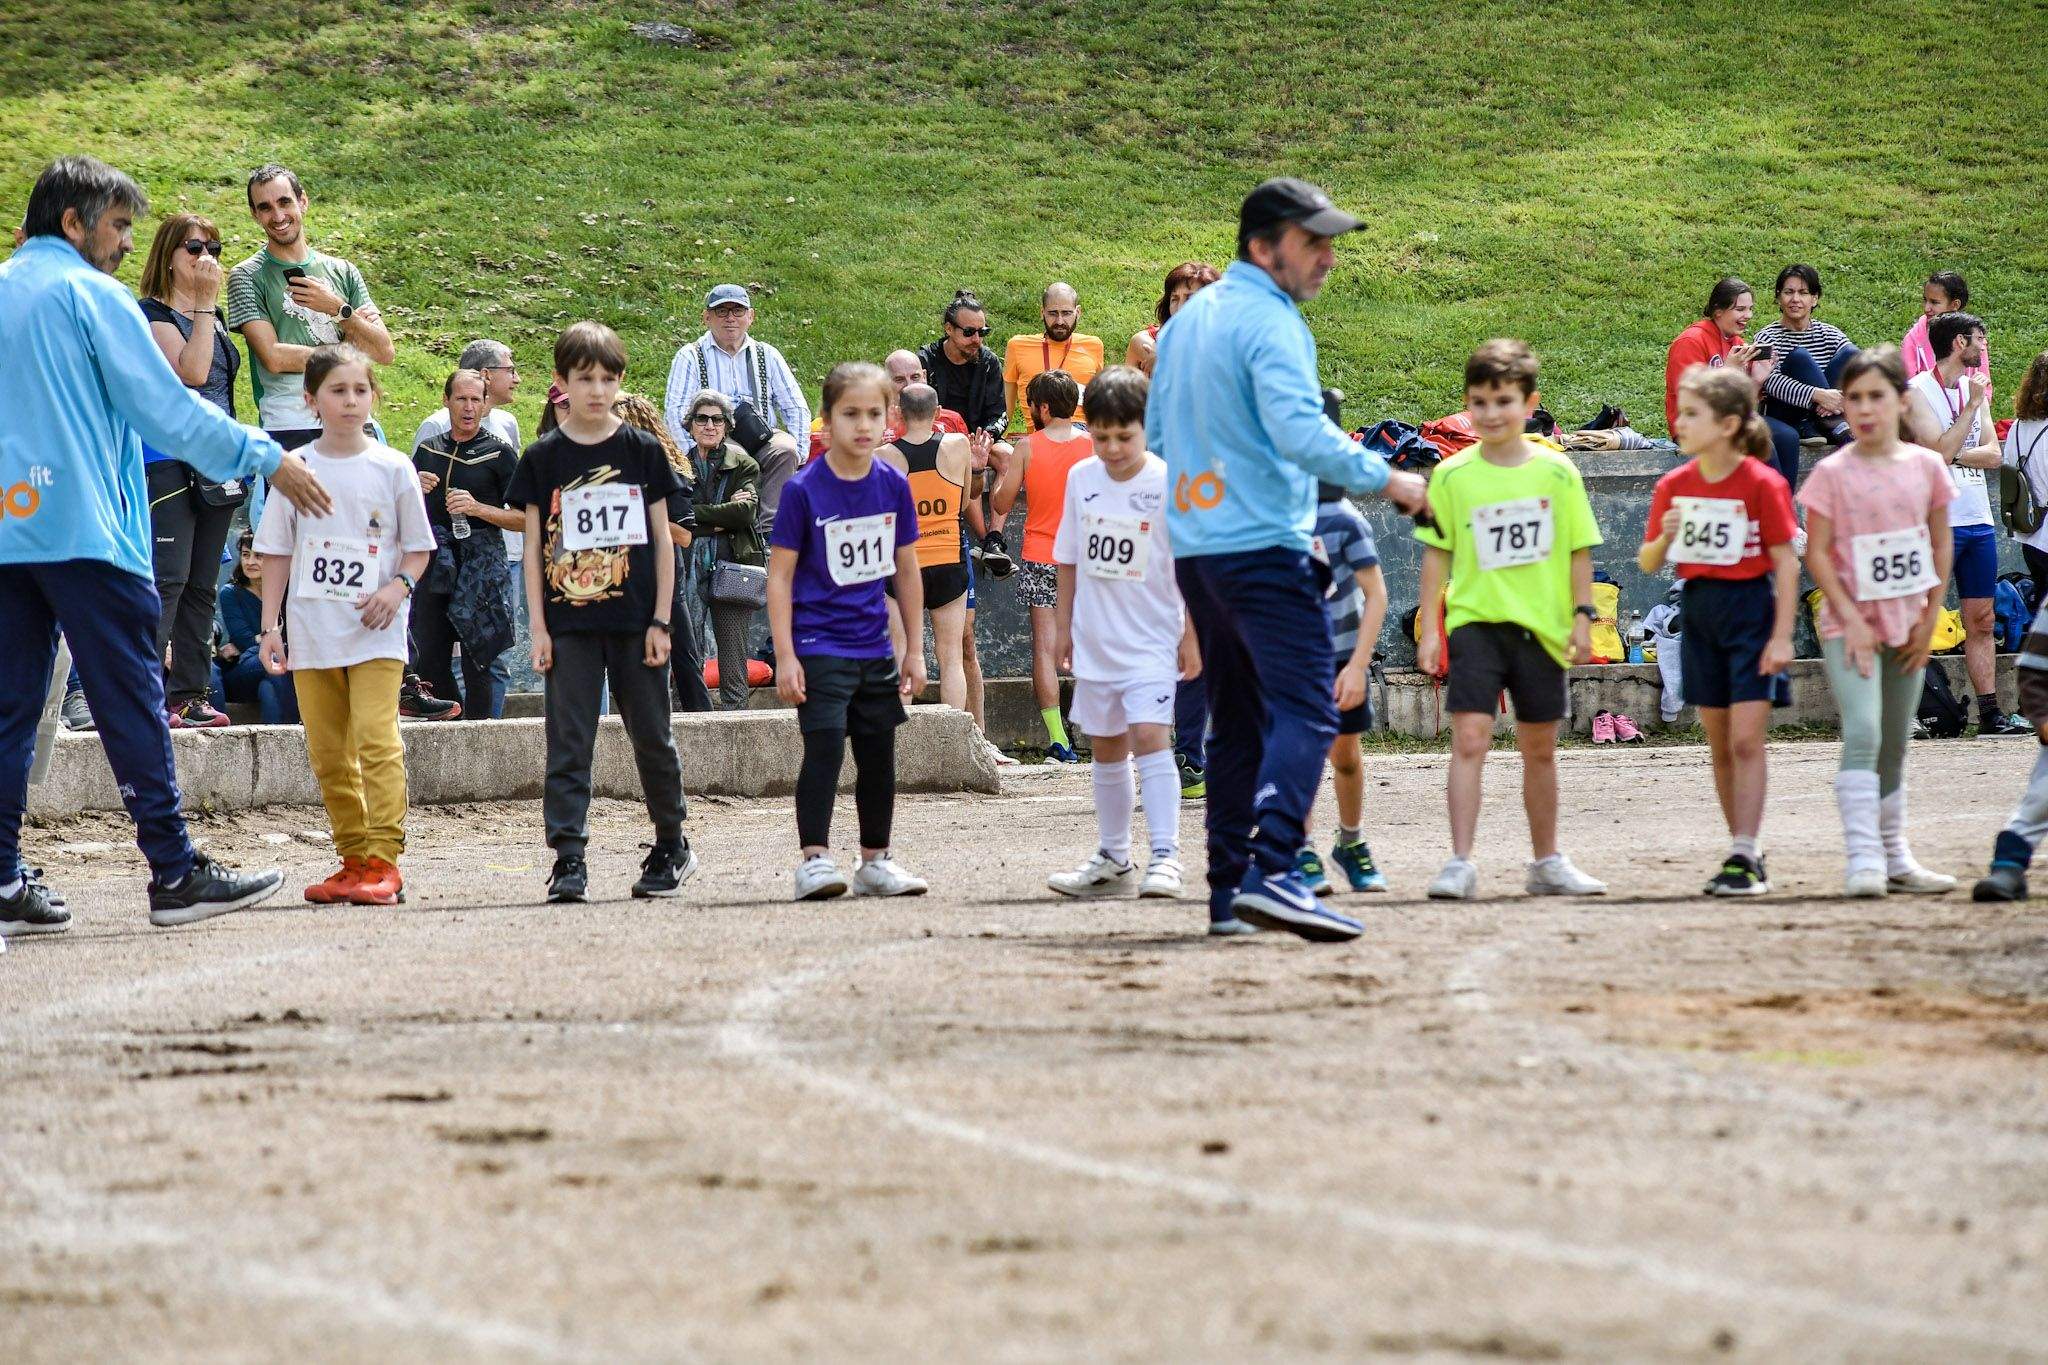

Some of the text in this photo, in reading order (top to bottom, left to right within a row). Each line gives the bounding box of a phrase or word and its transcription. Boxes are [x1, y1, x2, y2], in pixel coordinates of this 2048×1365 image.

[0, 481, 40, 520] O
[577, 505, 629, 534] 817
[1684, 521, 1730, 548] 845
[839, 536, 883, 568] 911
[1088, 533, 1134, 565] 809
[1489, 521, 1541, 552] 787
[312, 557, 365, 588] 832
[1873, 550, 1921, 582] 856
